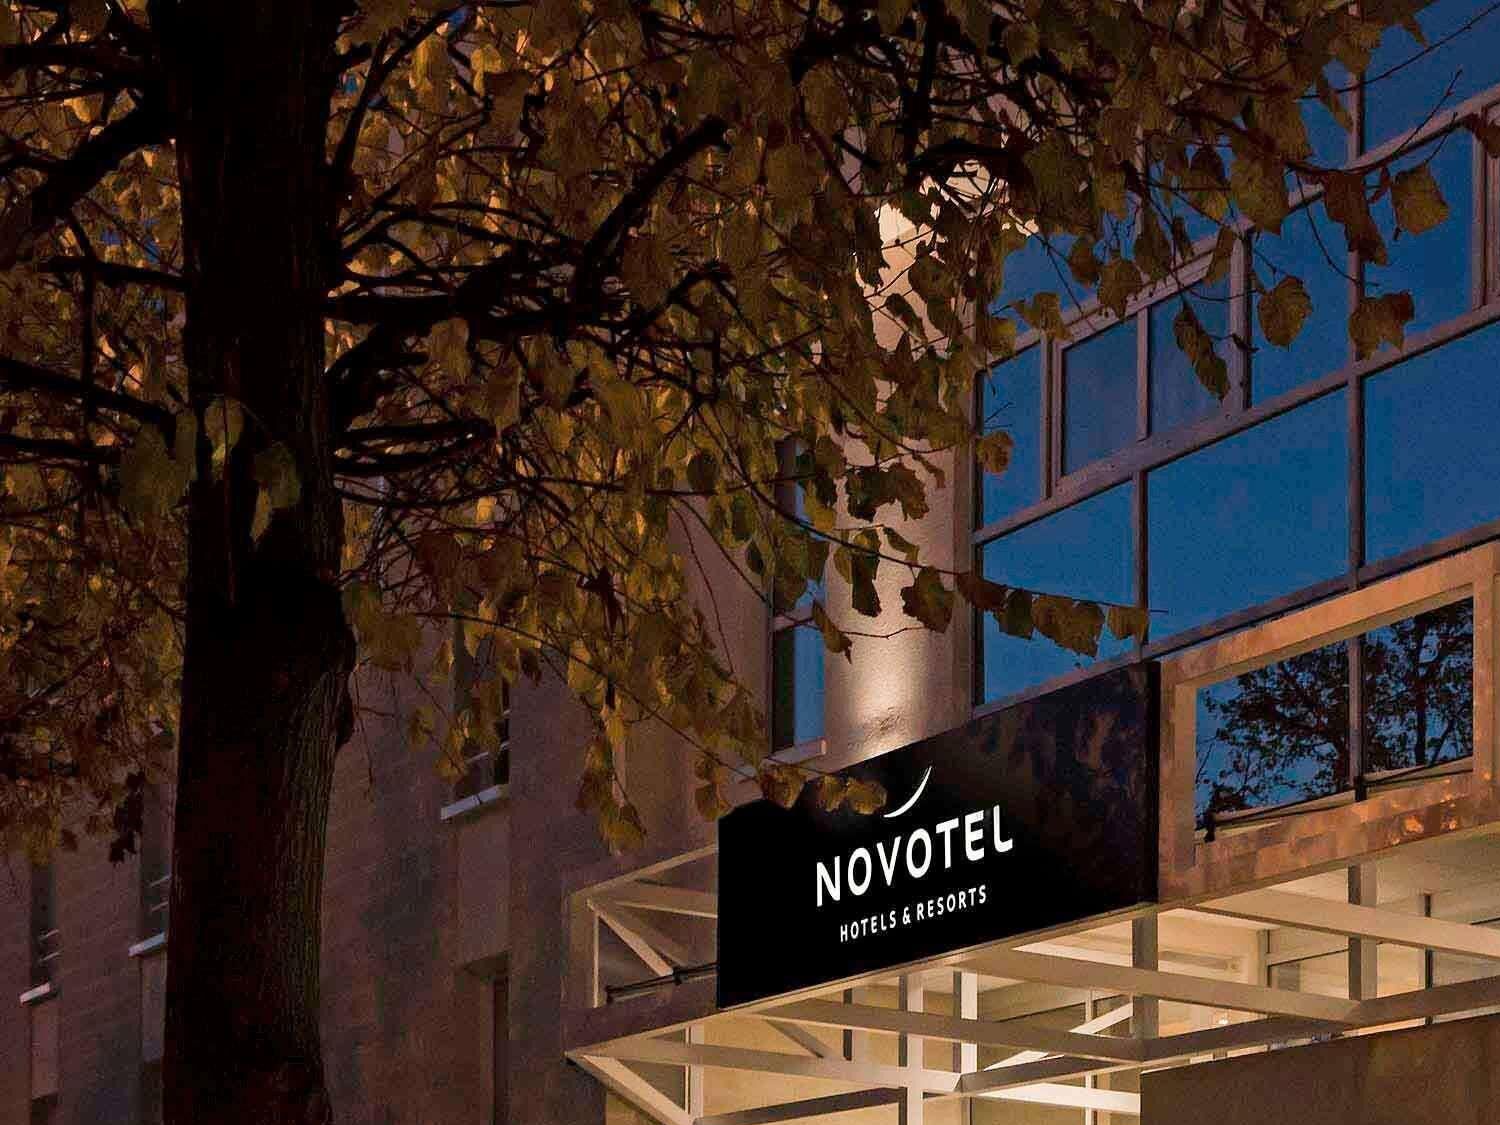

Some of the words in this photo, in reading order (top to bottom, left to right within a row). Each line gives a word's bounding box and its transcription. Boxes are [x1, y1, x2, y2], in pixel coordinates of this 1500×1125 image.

[816, 804, 1014, 907] NOVOTEL
[840, 910, 897, 943] HOTELS
[902, 906, 911, 925] &
[916, 884, 988, 921] RESORTS
